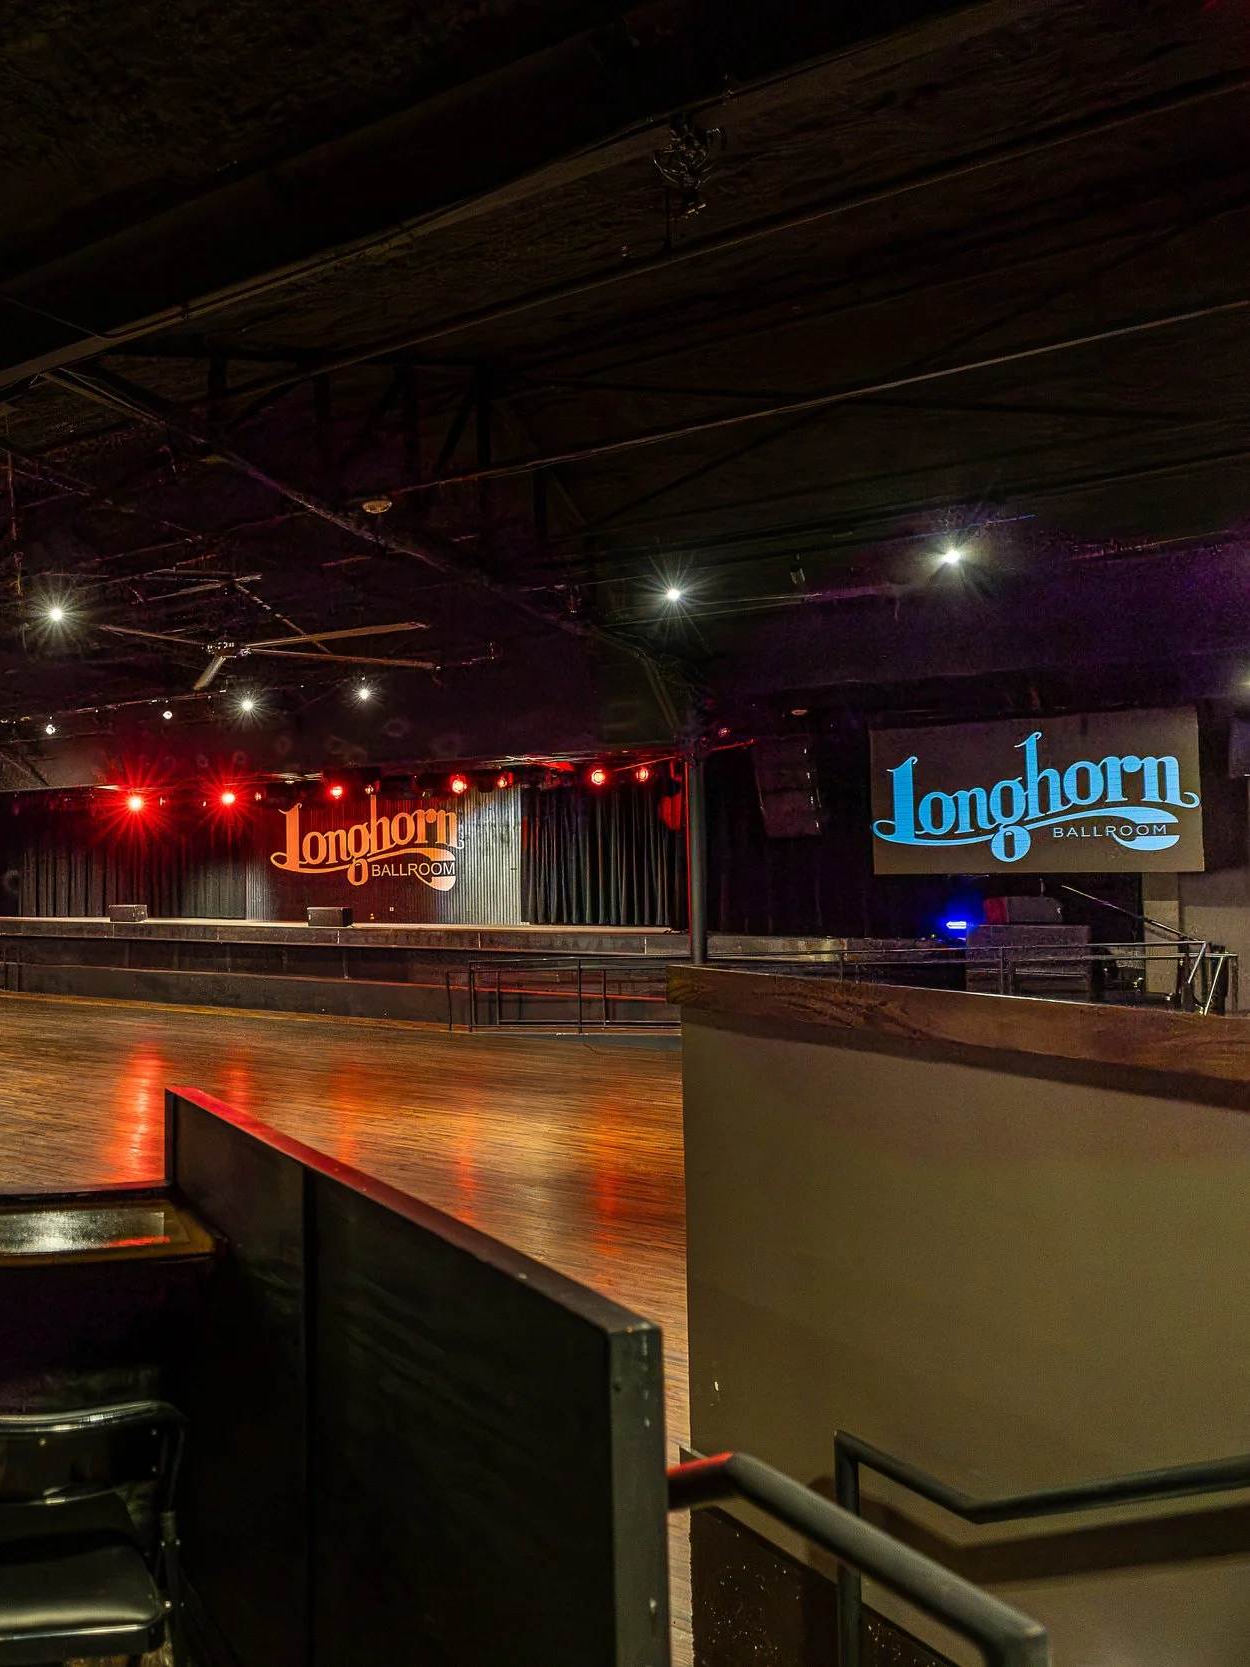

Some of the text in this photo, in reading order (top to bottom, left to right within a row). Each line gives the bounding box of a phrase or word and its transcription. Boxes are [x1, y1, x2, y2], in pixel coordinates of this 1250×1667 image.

[872, 731, 1201, 862] Longhorn
[270, 795, 465, 886] Longhorn
[1052, 824, 1168, 839] BALLROOM
[371, 862, 456, 877] BALLROOM
